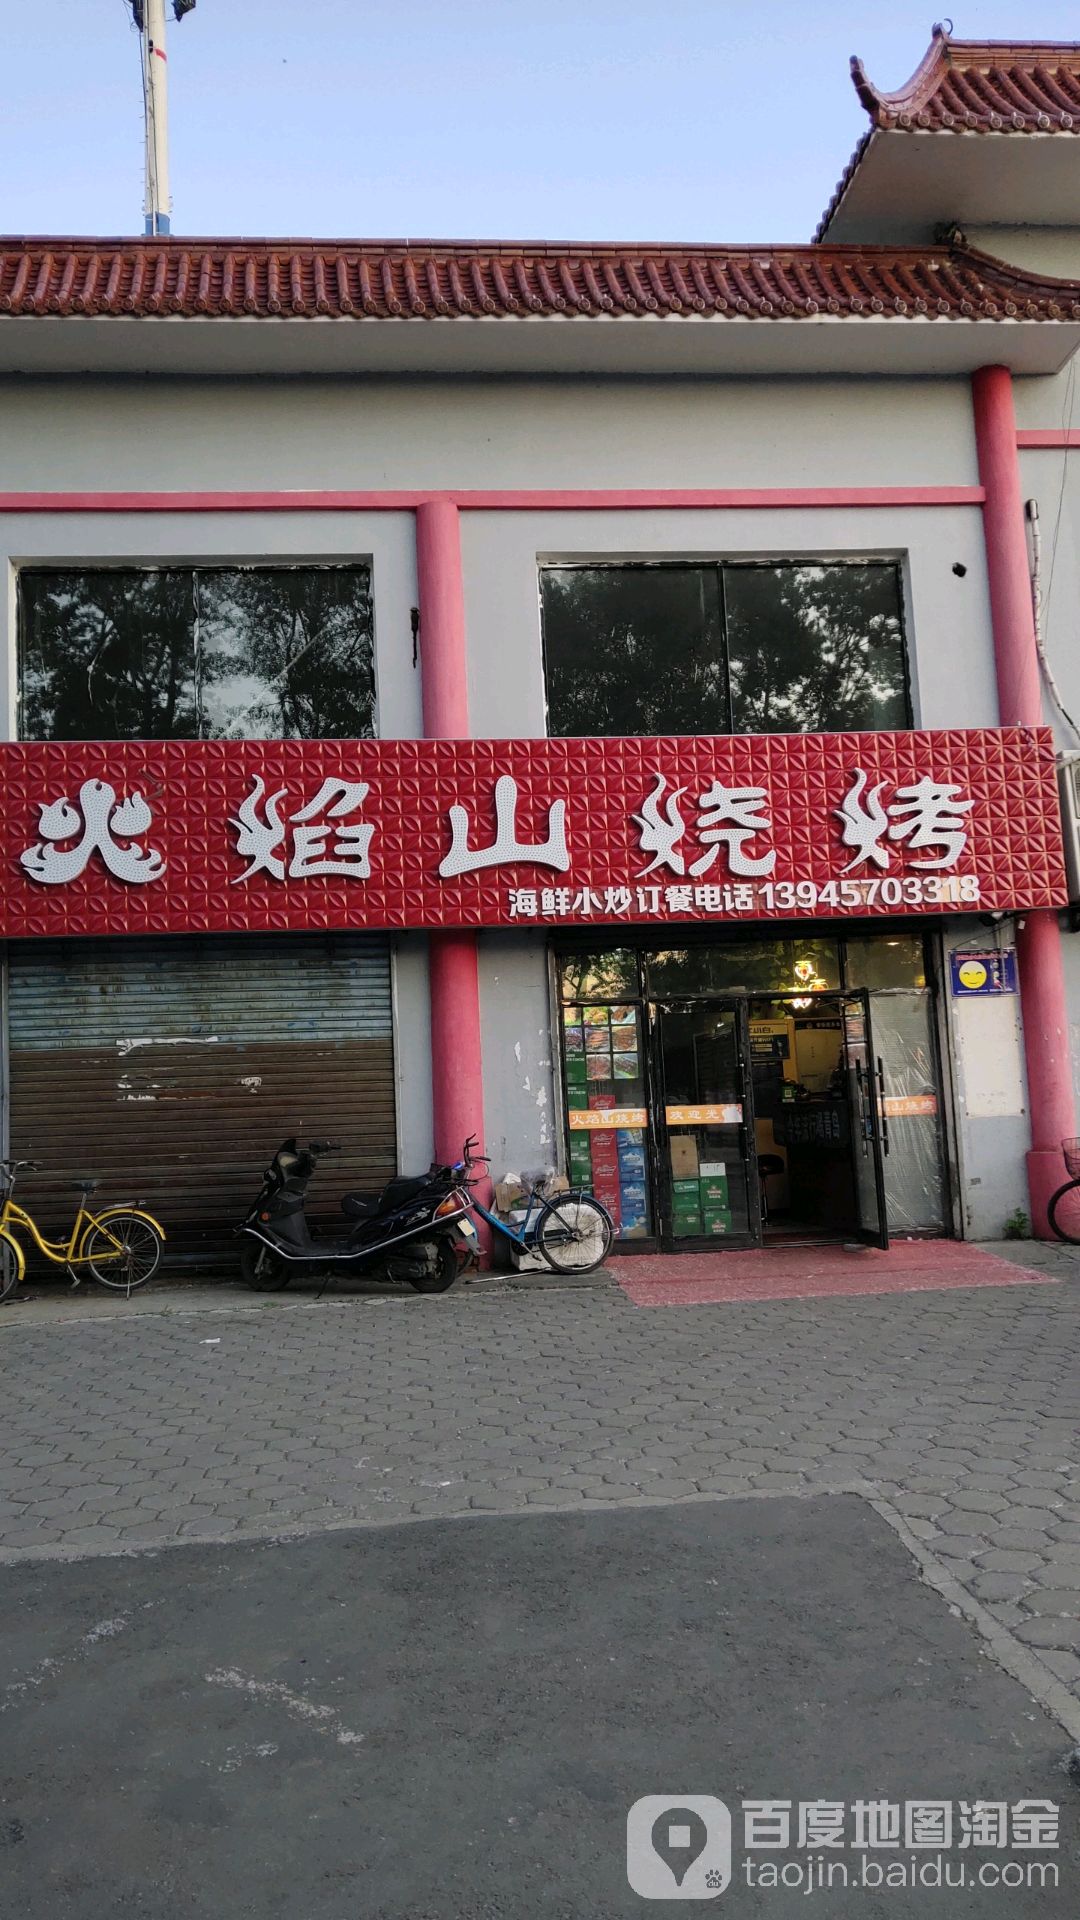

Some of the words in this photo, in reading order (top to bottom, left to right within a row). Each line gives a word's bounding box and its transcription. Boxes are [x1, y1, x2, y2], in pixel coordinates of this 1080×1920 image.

[20, 768, 975, 884] 火焰山烧烤
[508, 883, 753, 917] 海鲜小炒订餐电话
[758, 875, 980, 909] 13945703318
[669, 1109, 722, 1121] 欢迎光
